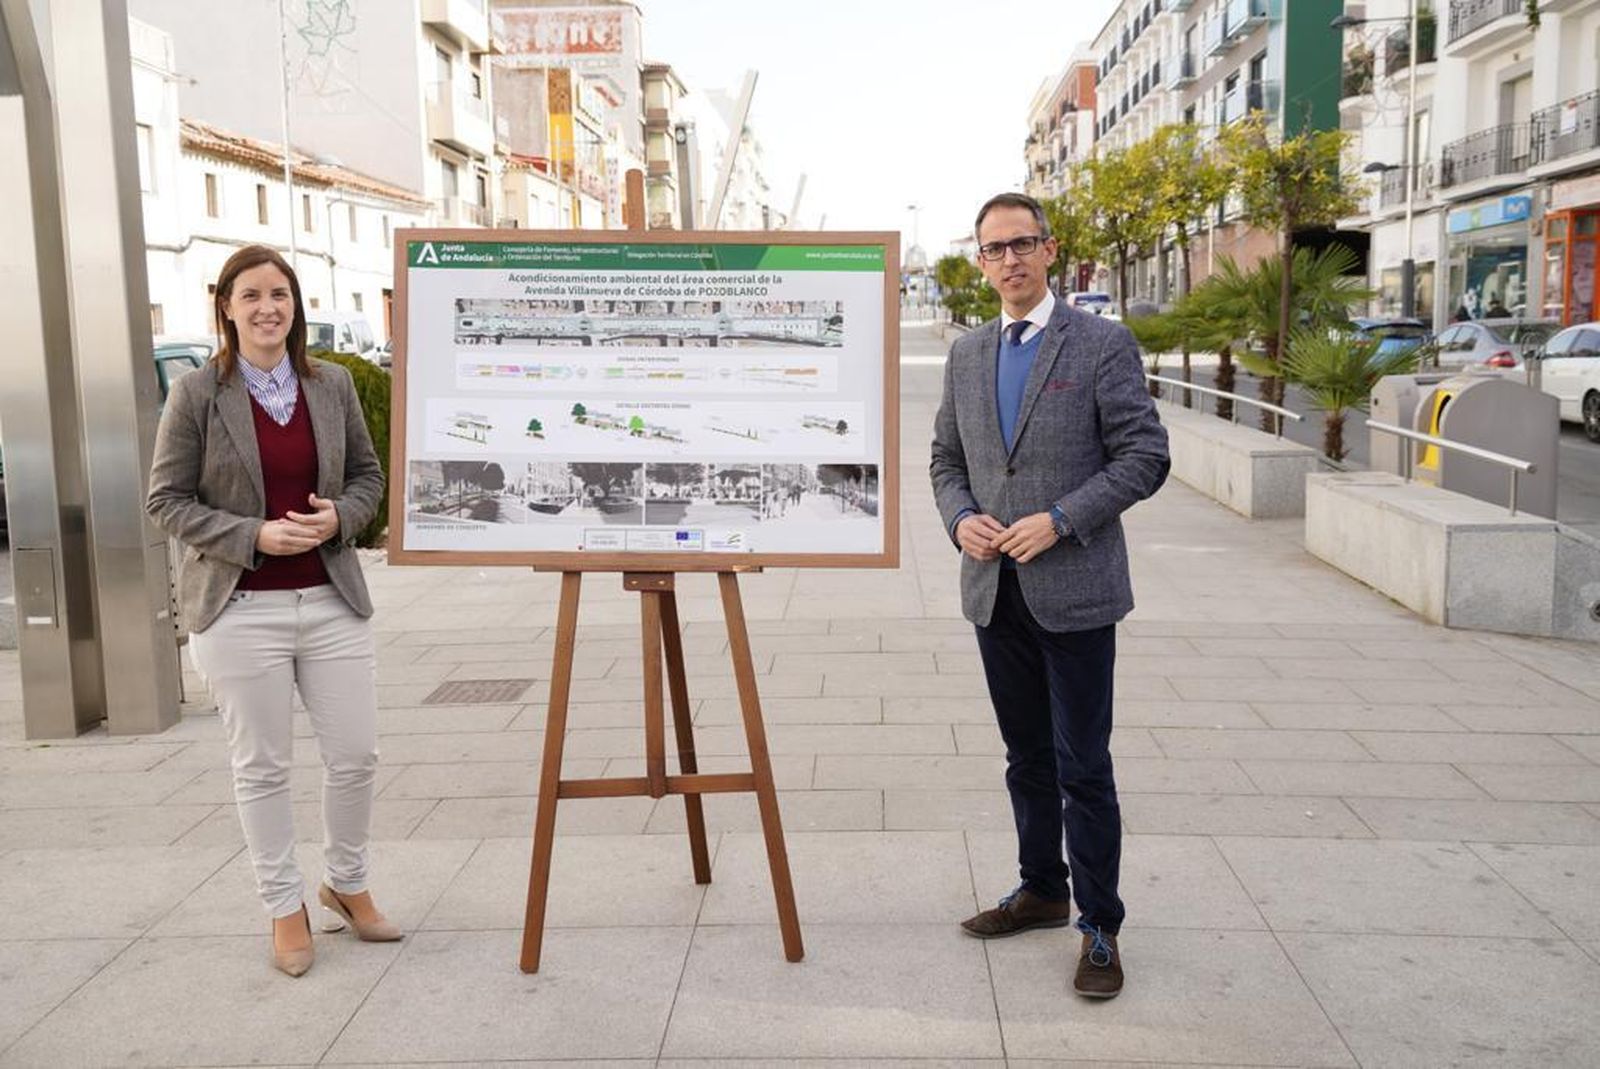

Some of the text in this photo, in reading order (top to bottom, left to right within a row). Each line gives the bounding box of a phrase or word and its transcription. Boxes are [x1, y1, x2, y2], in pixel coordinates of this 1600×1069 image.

[441, 244, 465, 252] Junta
[440, 253, 493, 261] de Andalucía
[508, 273, 783, 284] Acondicionamiento ambiental del área comercial de la
[524, 285, 768, 296] Avenida Villanueva de Córdoba de POZOBLANCO
